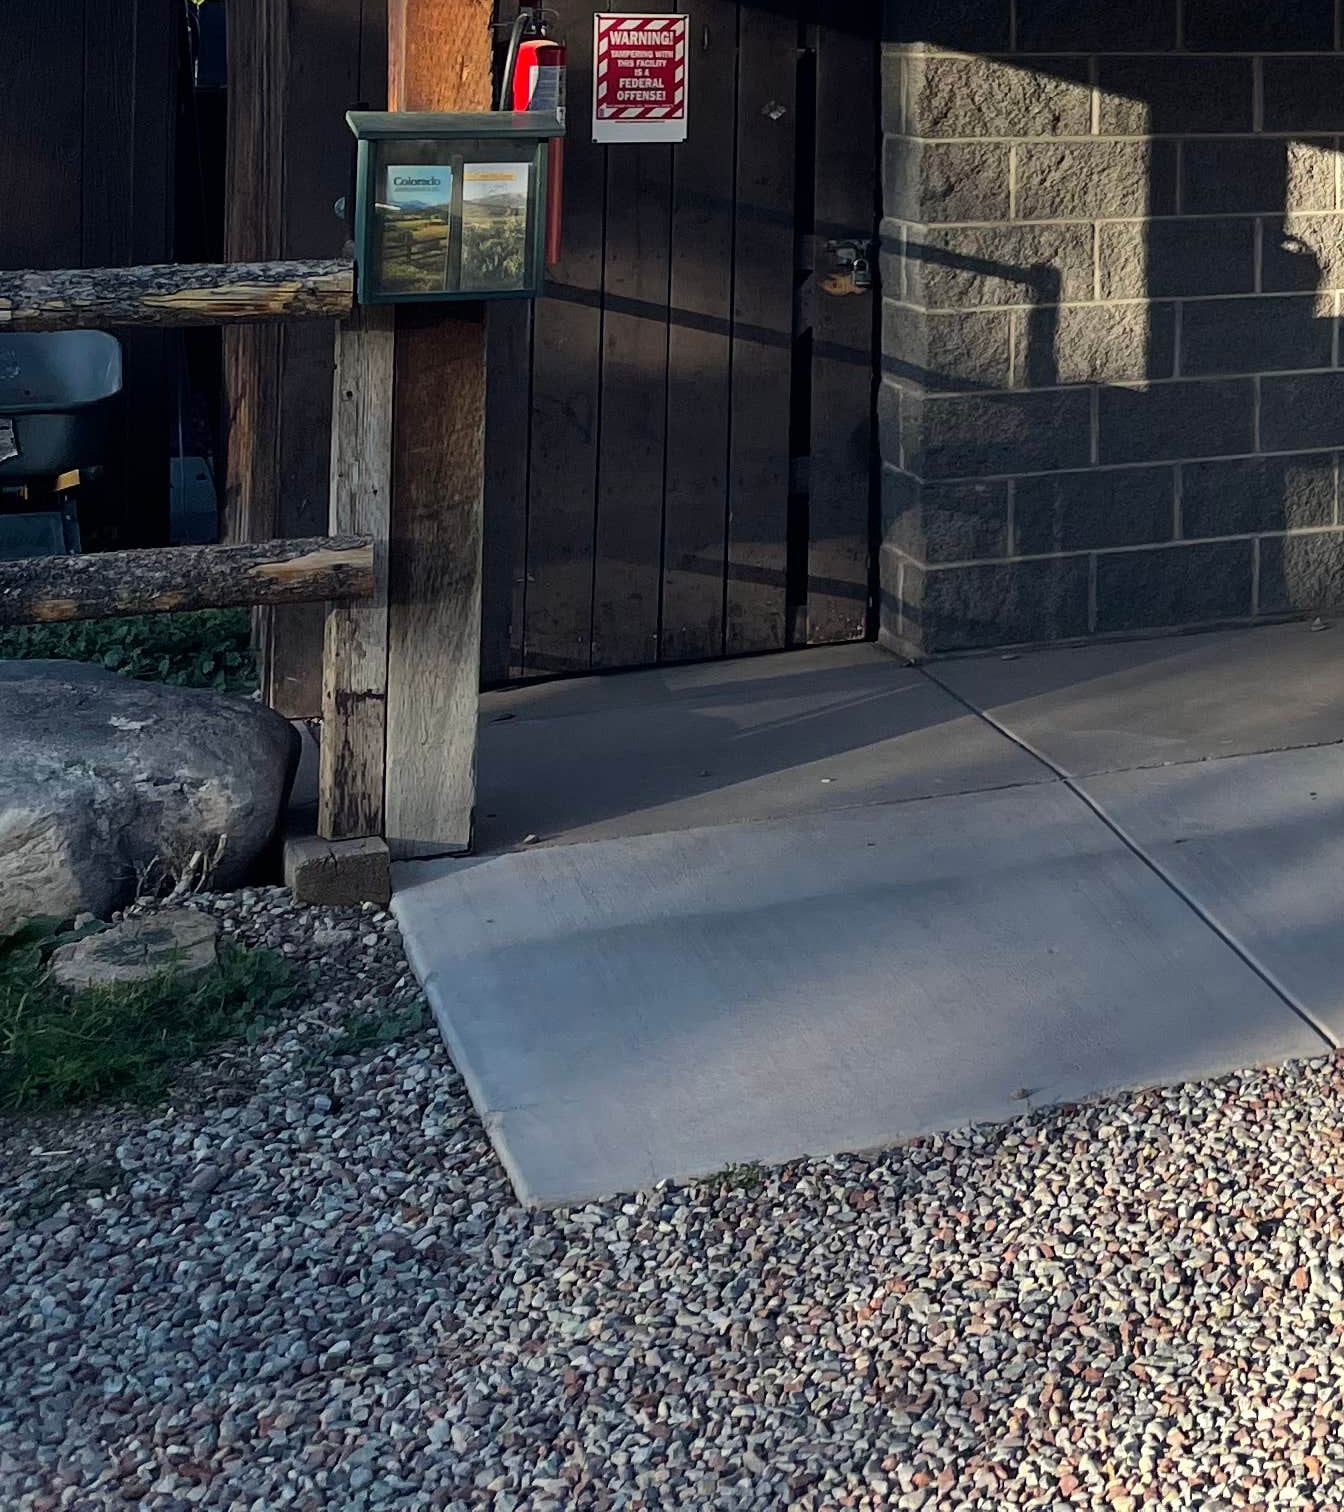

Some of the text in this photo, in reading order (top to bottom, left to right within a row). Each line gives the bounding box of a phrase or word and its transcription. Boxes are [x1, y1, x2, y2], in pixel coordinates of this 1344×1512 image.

[609, 31, 674, 45] WARNING!
[611, 50, 674, 58] TAMPERING WITH
[617, 59, 667, 67] THIS FACILITY
[619, 78, 664, 89] FEDERAL
[617, 91, 665, 101] OFFENSE!
[393, 176, 441, 186] Colorado
